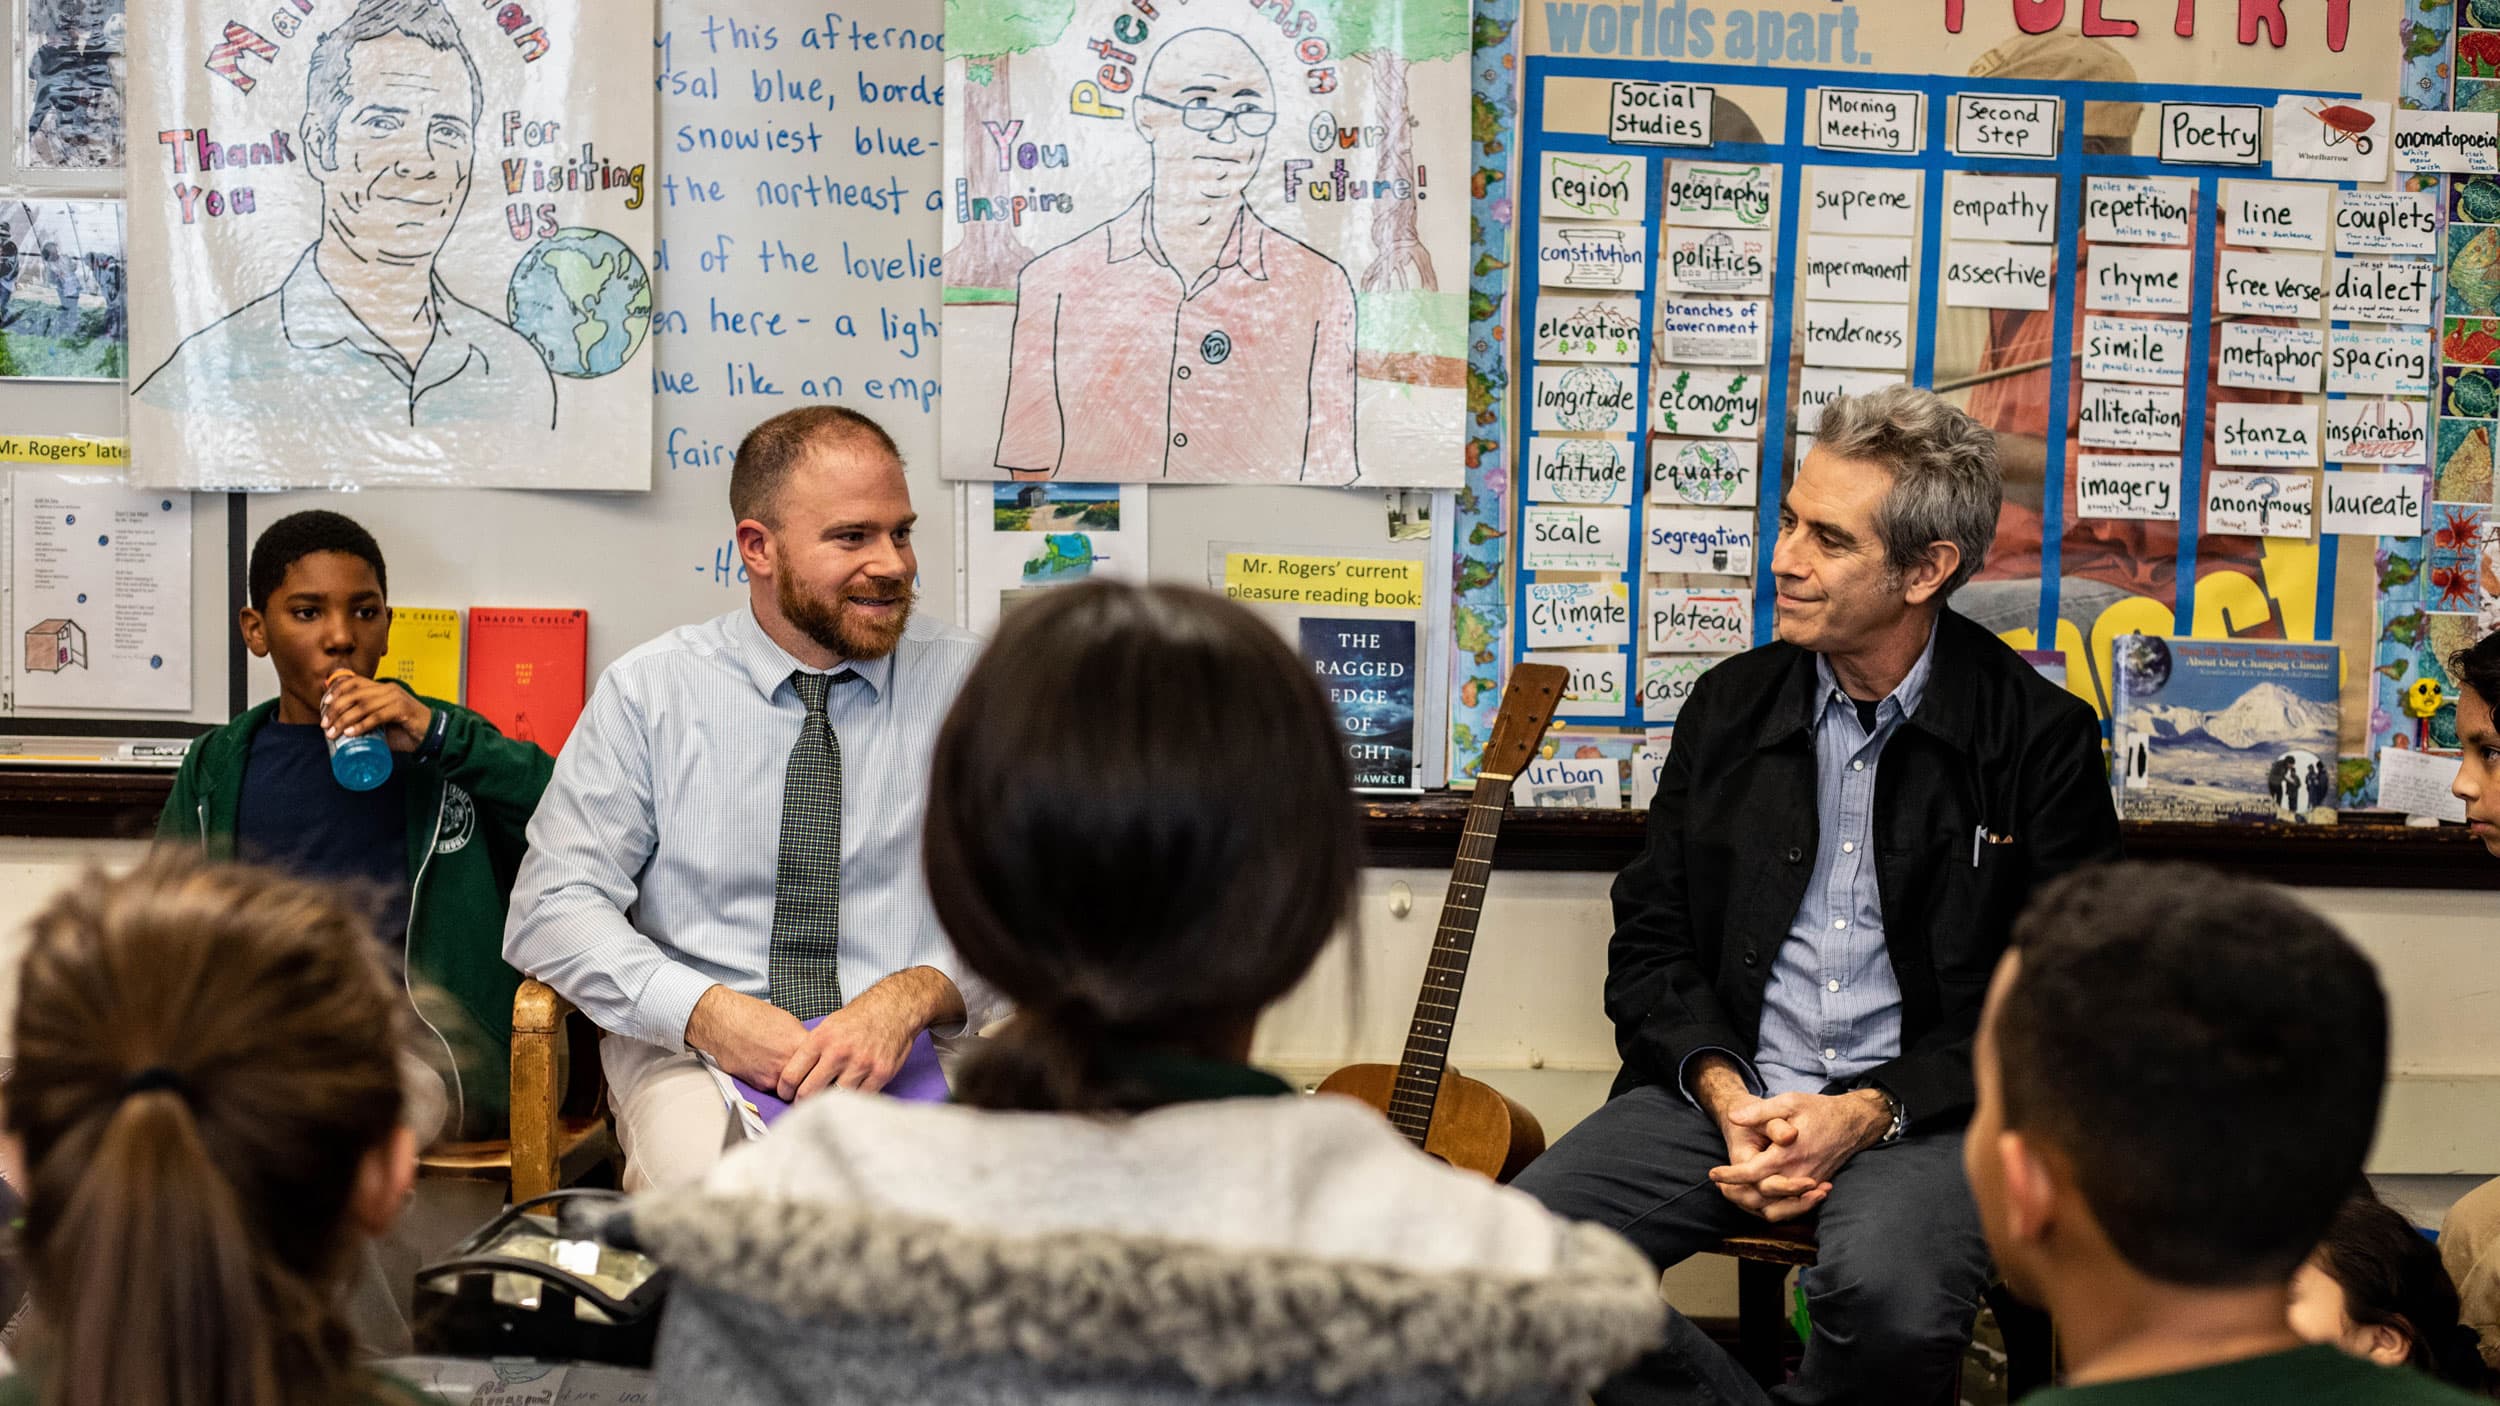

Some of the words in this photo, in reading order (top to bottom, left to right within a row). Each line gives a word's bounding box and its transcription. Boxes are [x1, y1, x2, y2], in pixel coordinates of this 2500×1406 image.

[701, 15, 779, 53] this
[1544, 0, 1715, 58] worlds
[1725, 2, 1872, 66] apart.
[752, 69, 835, 111] blue,
[1621, 85, 1696, 109] Social
[1829, 94, 1897, 122] Morning
[1966, 101, 2040, 123] Second
[502, 111, 560, 147] For
[676, 119, 823, 153] snowiest
[854, 126, 940, 157] blue-
[1308, 110, 1385, 153] Our
[1615, 112, 1702, 138] Studies
[1827, 121, 1900, 148] Meeting
[1977, 125, 2030, 148] Step
[2173, 111, 2258, 158] Poetry
[2394, 124, 2498, 154] onomatopoeia
[159, 129, 298, 174] Thank
[983, 119, 1069, 172] You
[2298, 152, 2349, 163] Wheelbarrow
[501, 142, 645, 210] Visiting
[1284, 158, 1427, 202] Future!
[1551, 175, 1629, 206] region
[174, 184, 256, 225] You
[662, 174, 726, 208] the
[756, 174, 910, 215] northeast
[956, 177, 1073, 226] Inspire
[1670, 181, 1769, 214] geography
[1816, 190, 1911, 220] supreme
[2090, 193, 2187, 228] repetition
[506, 202, 559, 241] US
[1953, 191, 2049, 232] empathy
[2243, 199, 2292, 225] line
[2336, 201, 2436, 236] couplets
[701, 234, 734, 273] of
[759, 239, 819, 273] the
[1540, 242, 1643, 264] constitution
[1672, 244, 1762, 276] politics
[1807, 256, 1911, 288] impermanent
[1947, 257, 2047, 288] assertive
[2099, 262, 2180, 297] rhyme
[2225, 268, 2270, 296] free
[2335, 267, 2427, 301] dialect
[1666, 300, 1733, 317] branches
[1740, 302, 1758, 317] of
[835, 314, 857, 337] a
[881, 307, 942, 358] ligh
[1539, 316, 1640, 339] elevation
[1665, 318, 1759, 335] Government
[1806, 317, 1903, 349] tenderness
[2089, 333, 2165, 362] simile
[2223, 337, 2323, 377] metaphor
[2332, 347, 2425, 380] spacing
[727, 361, 784, 397] like
[801, 374, 843, 397] an
[1537, 381, 1635, 416] longitude
[1659, 391, 1759, 426] economy
[2080, 397, 2182, 428] alliteration
[2224, 418, 2308, 445] stanza
[2326, 418, 2424, 445] inspiration
[1535, 453, 1627, 483] latitude
[1654, 463, 1750, 492] equator
[2080, 476, 2170, 509] imagery
[2328, 484, 2419, 517] laureate
[2209, 496, 2312, 524] anonymous
[1535, 515, 1601, 544] scale
[1242, 558, 1272, 574] Mr.
[1278, 559, 1341, 580] Rogers'
[1345, 563, 1409, 579] current
[1227, 584, 1300, 601] pleasure
[1305, 586, 1369, 606] reading
[1374, 589, 1422, 606] book:
[477, 615, 524, 623] SHARON
[531, 616, 576, 625] CREECH
[1654, 605, 1741, 643] plateau
[1338, 633, 1381, 649] THE
[1314, 660, 1405, 677] RAGGED
[1330, 688, 1388, 705] EDGE
[1345, 716, 1372, 732] OF
[1353, 774, 1406, 785] HAWKER
